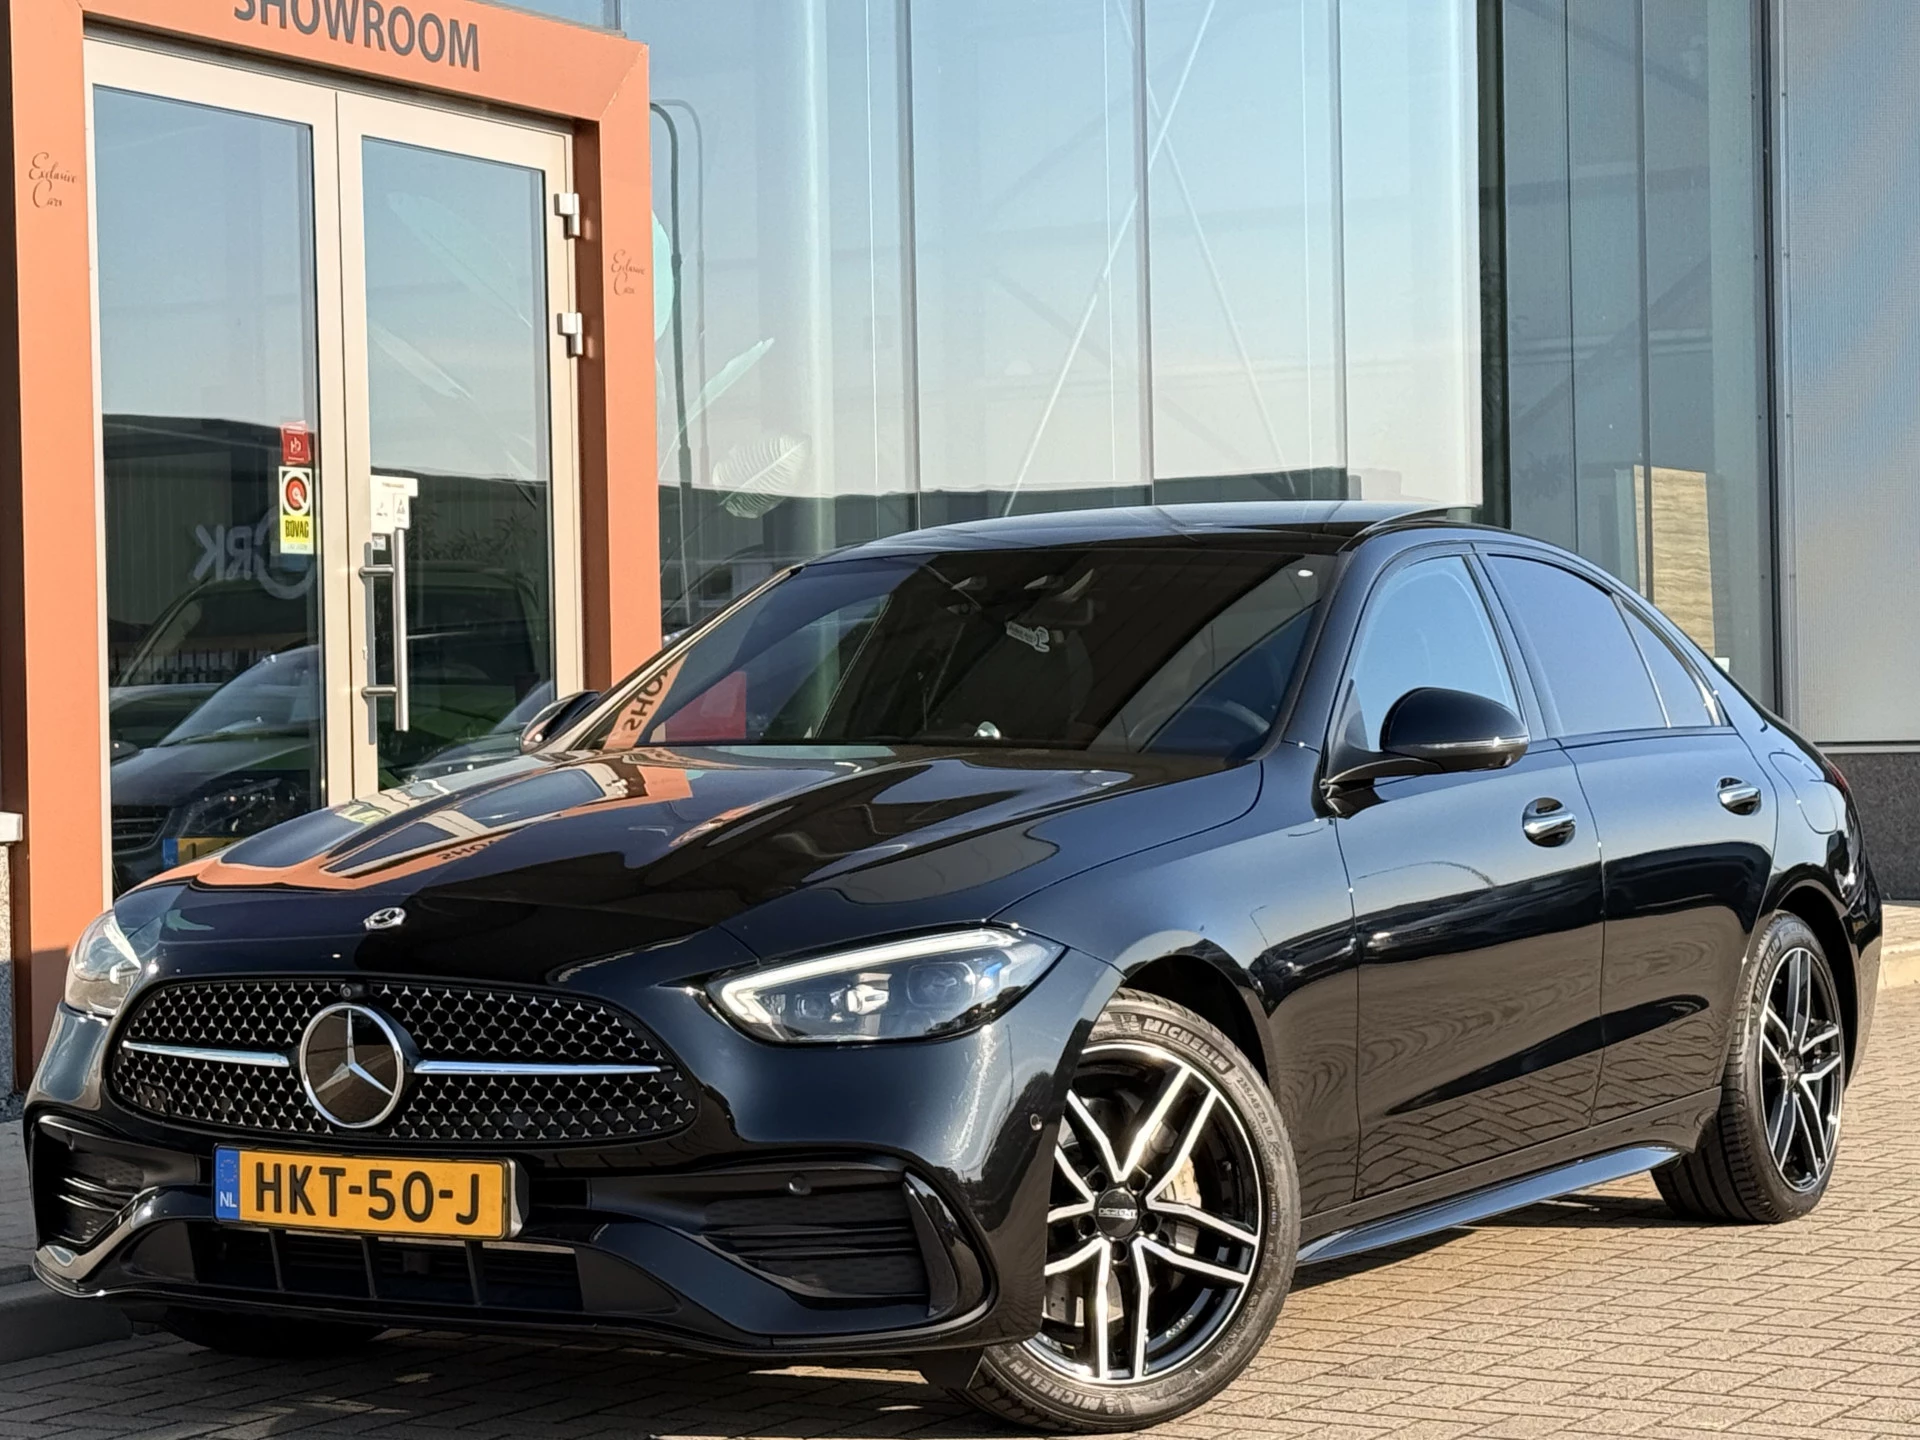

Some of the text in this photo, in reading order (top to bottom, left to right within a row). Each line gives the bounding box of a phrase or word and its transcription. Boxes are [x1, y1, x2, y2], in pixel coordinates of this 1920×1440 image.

[284, 519, 309, 539] BOVAG
[1143, 1017, 1231, 1071] MICHELIN
[219, 1190, 238, 1209] NL
[255, 1161, 480, 1226] HKT-50-J
[1008, 1360, 1101, 1411] MICHELIN
